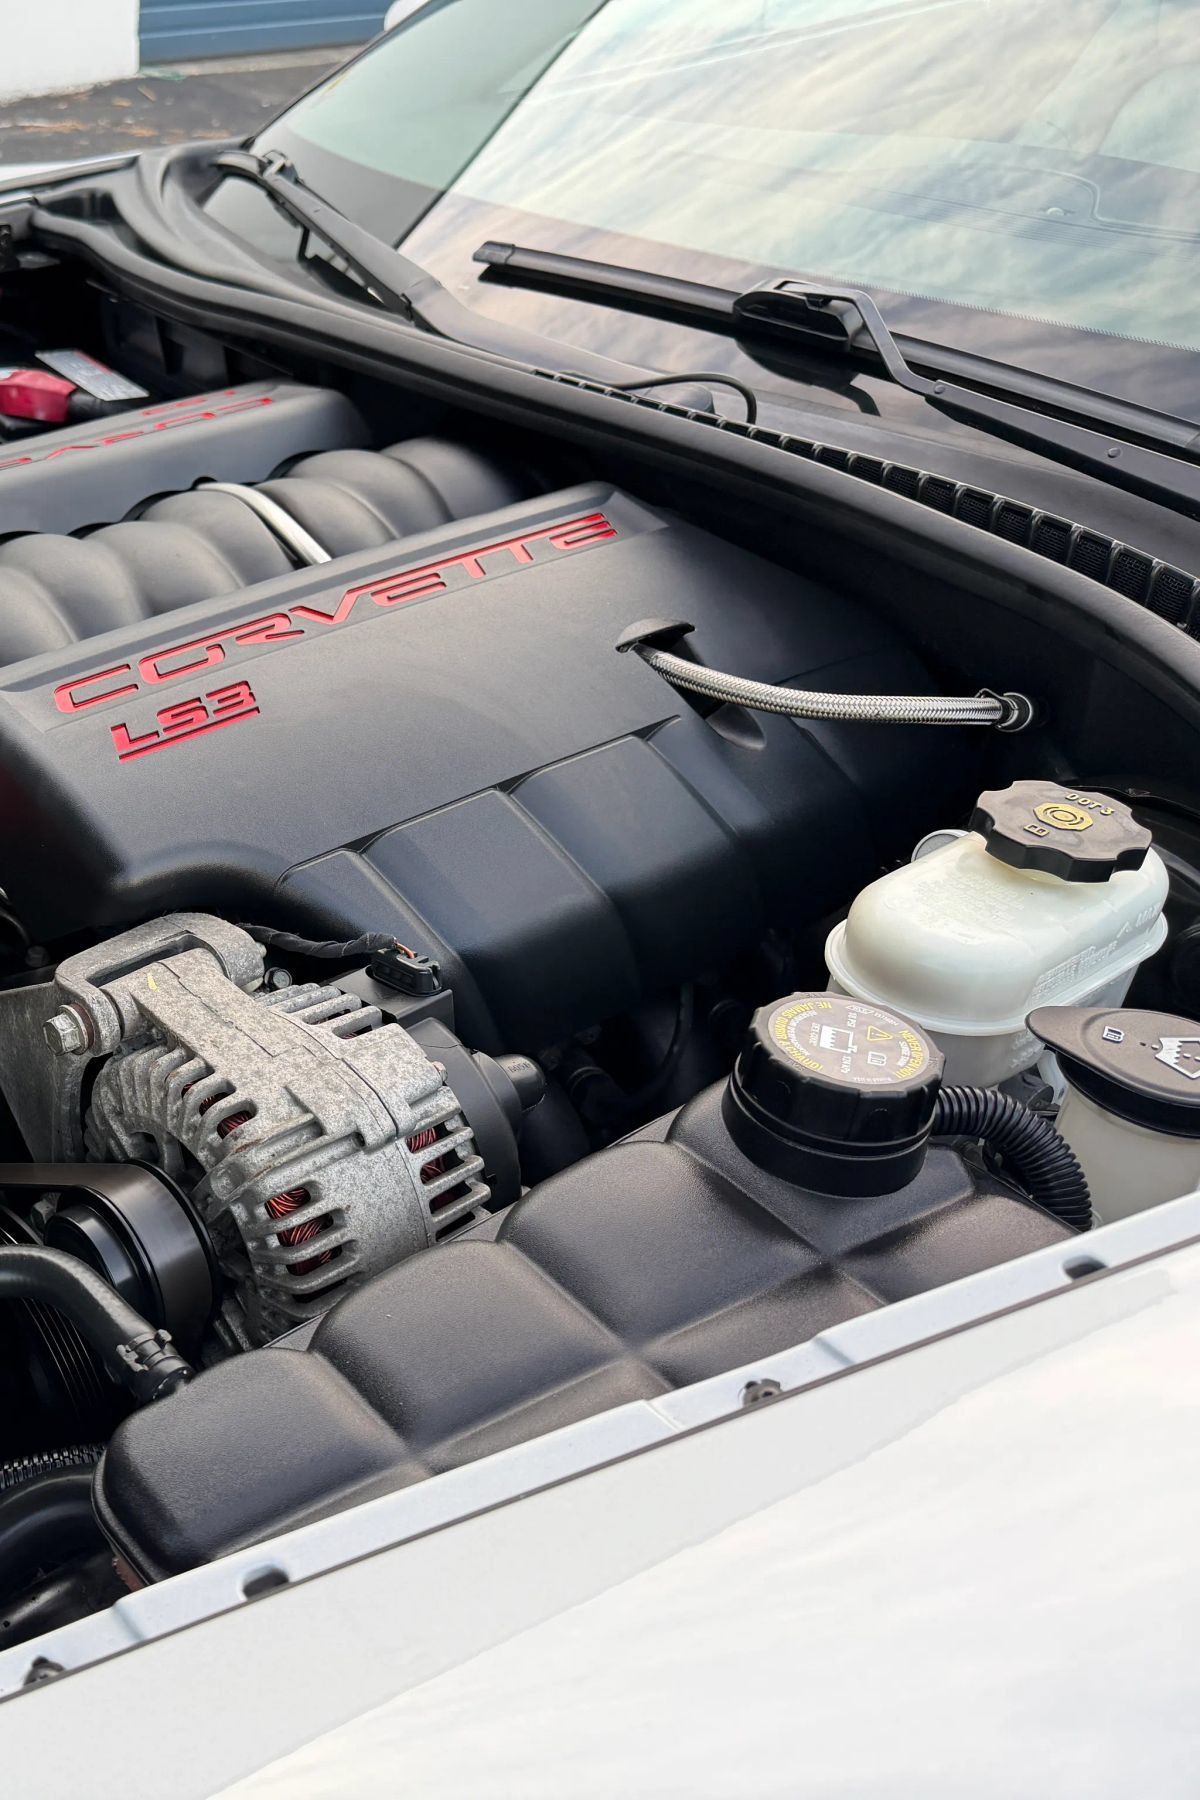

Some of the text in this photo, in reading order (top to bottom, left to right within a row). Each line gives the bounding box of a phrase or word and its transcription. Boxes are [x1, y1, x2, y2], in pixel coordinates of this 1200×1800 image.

[53, 511, 618, 714] CORVETTE
[109, 679, 259, 755] LS3
[1064, 792, 1115, 816] DOT 3
[782, 1002, 814, 1018] JAMAIS
[898, 1029, 922, 1051] NEVER
